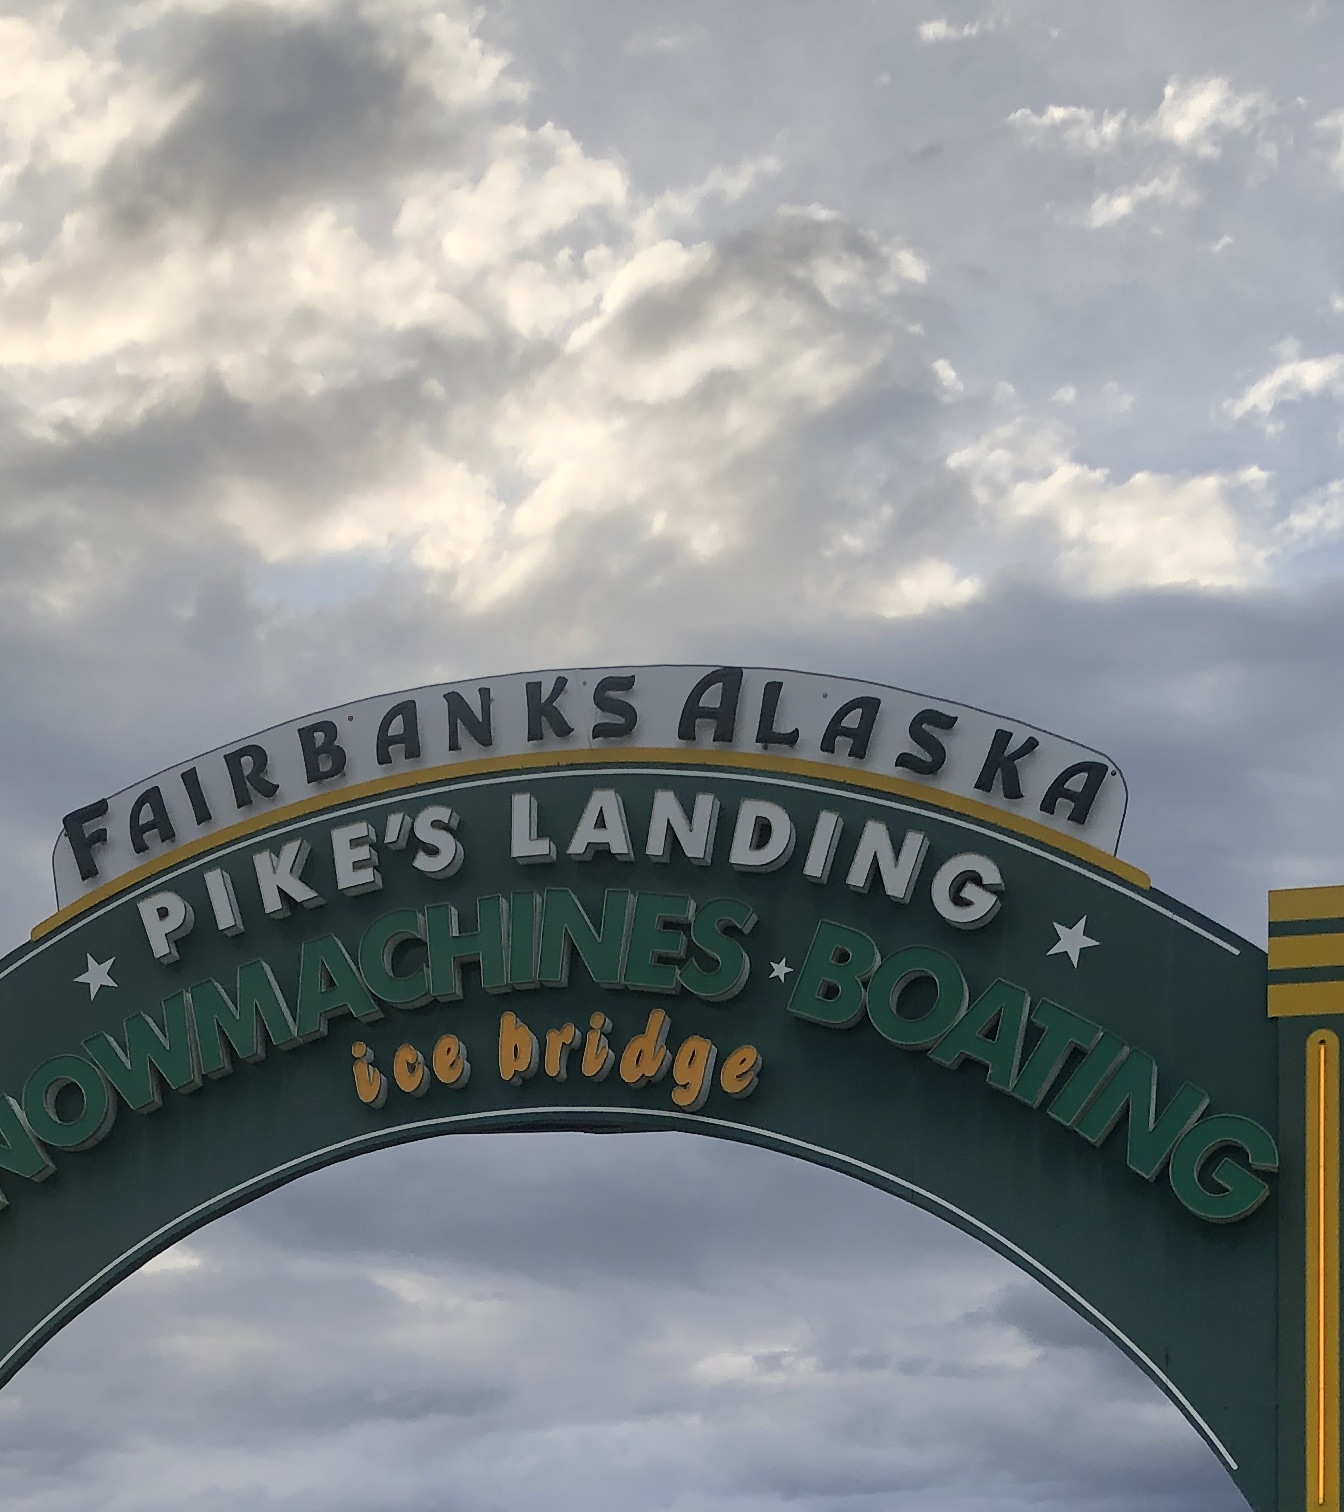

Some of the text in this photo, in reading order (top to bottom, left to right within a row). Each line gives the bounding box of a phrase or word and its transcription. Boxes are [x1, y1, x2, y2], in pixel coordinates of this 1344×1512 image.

[62, 667, 1108, 880] FAIRBANKS ALASKA
[137, 788, 1005, 964] PIKE'S LANDING
[352, 1009, 763, 1111] ice bridge
[787, 918, 1279, 1223] BOATING
